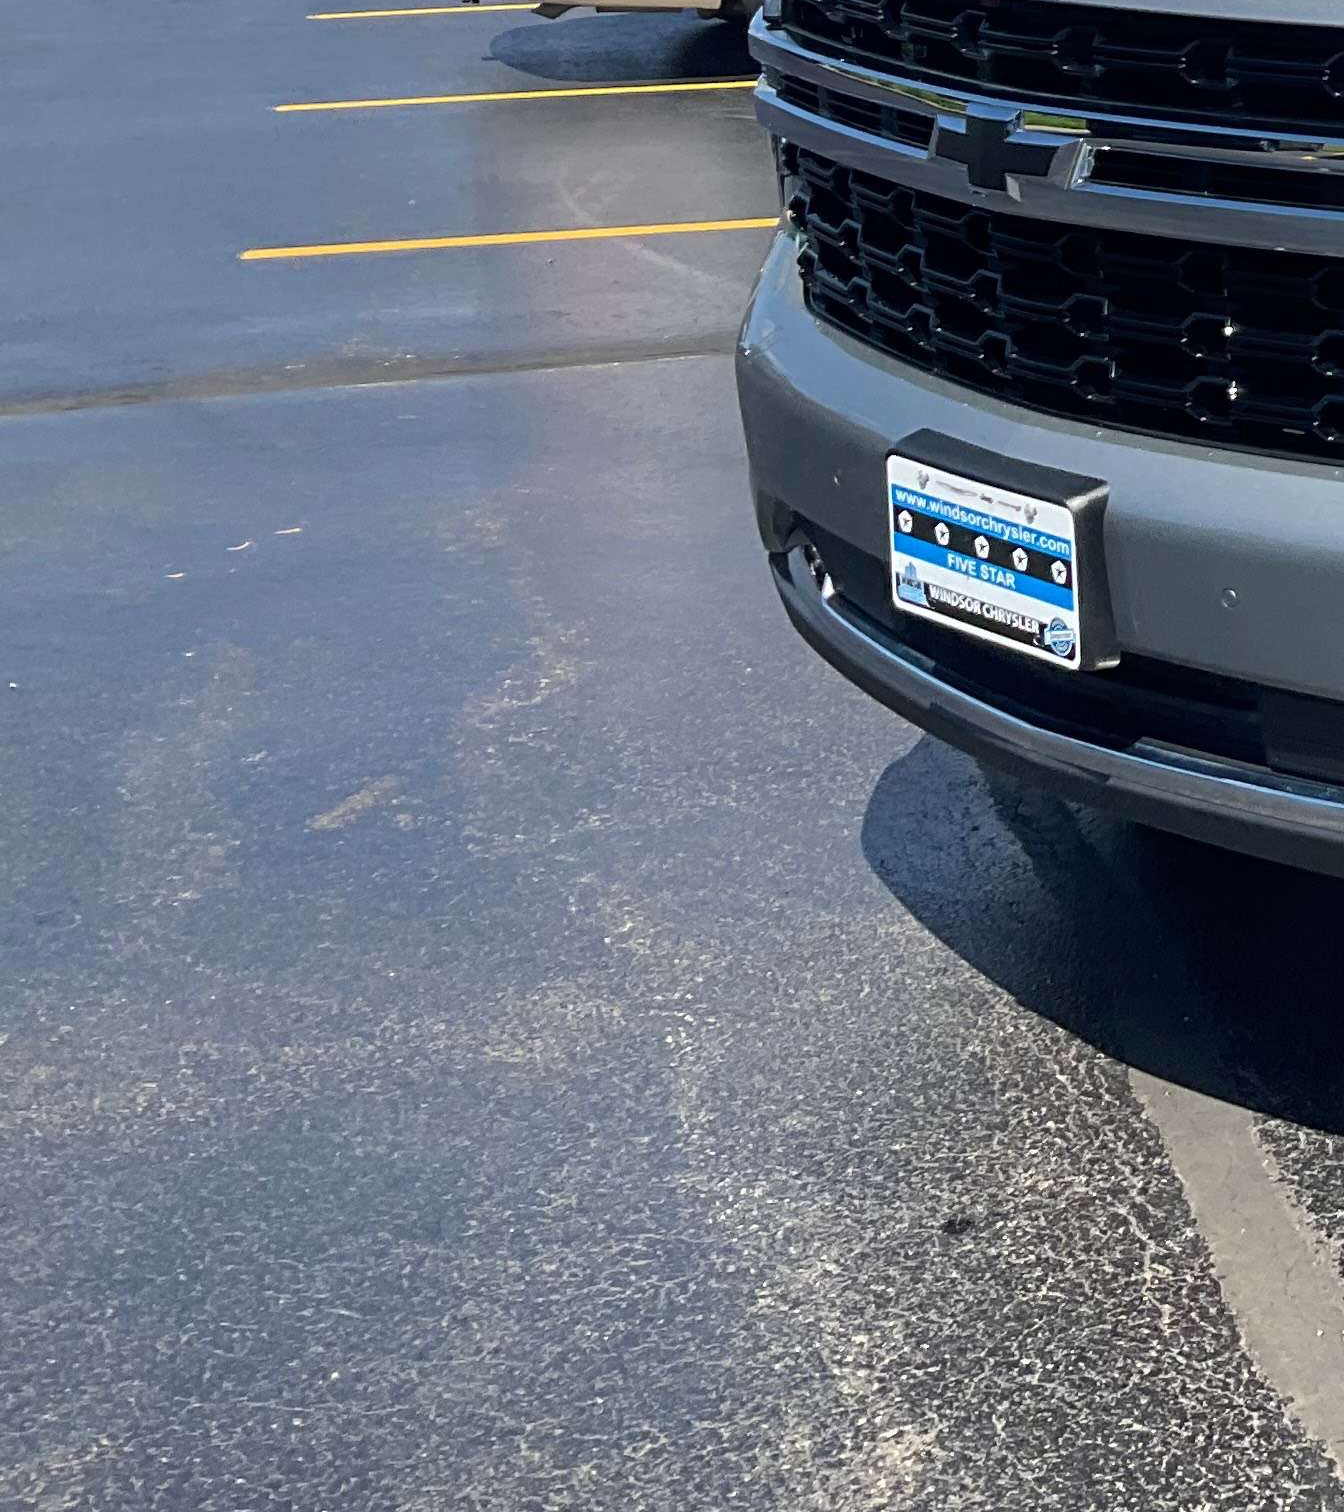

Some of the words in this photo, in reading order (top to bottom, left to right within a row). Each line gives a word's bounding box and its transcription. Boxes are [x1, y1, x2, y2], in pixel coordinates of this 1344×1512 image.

[894, 489, 1071, 556] www.windsorchrysler.com
[946, 553, 977, 578] FIVE
[980, 563, 1016, 590] STAR
[928, 583, 982, 616] WINDSOR
[982, 600, 1041, 635] CHRYSLER
